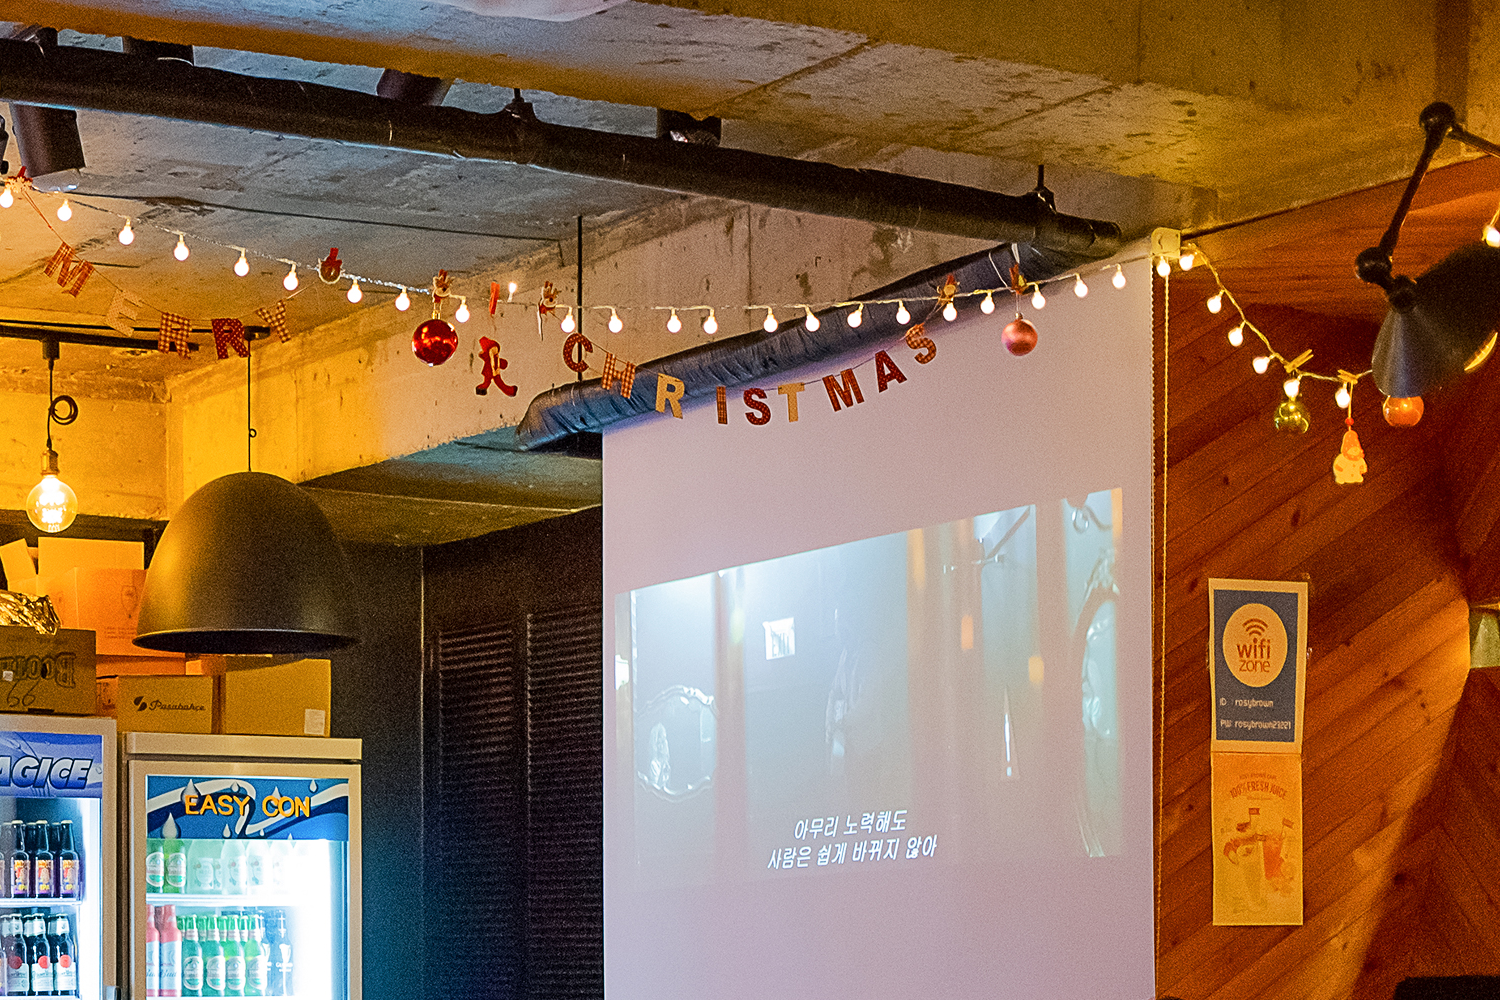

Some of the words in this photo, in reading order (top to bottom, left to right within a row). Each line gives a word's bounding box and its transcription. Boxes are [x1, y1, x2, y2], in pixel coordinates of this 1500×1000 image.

[44, 242, 292, 359] MERRY
[563, 322, 938, 426] CHRISTMAS
[1237, 637, 1271, 660] wifi
[1238, 659, 1271, 673] zone
[1235, 698, 1274, 709] rosybrown
[184, 794, 251, 816] EASY
[262, 796, 311, 818] CON
[794, 815, 839, 840] 아무리
[843, 809, 908, 835] 노력해도
[767, 846, 812, 870] 사람은
[817, 842, 847, 866] 쉽게
[851, 837, 900, 863] 바뀌지
[905, 834, 938, 860] 않아
